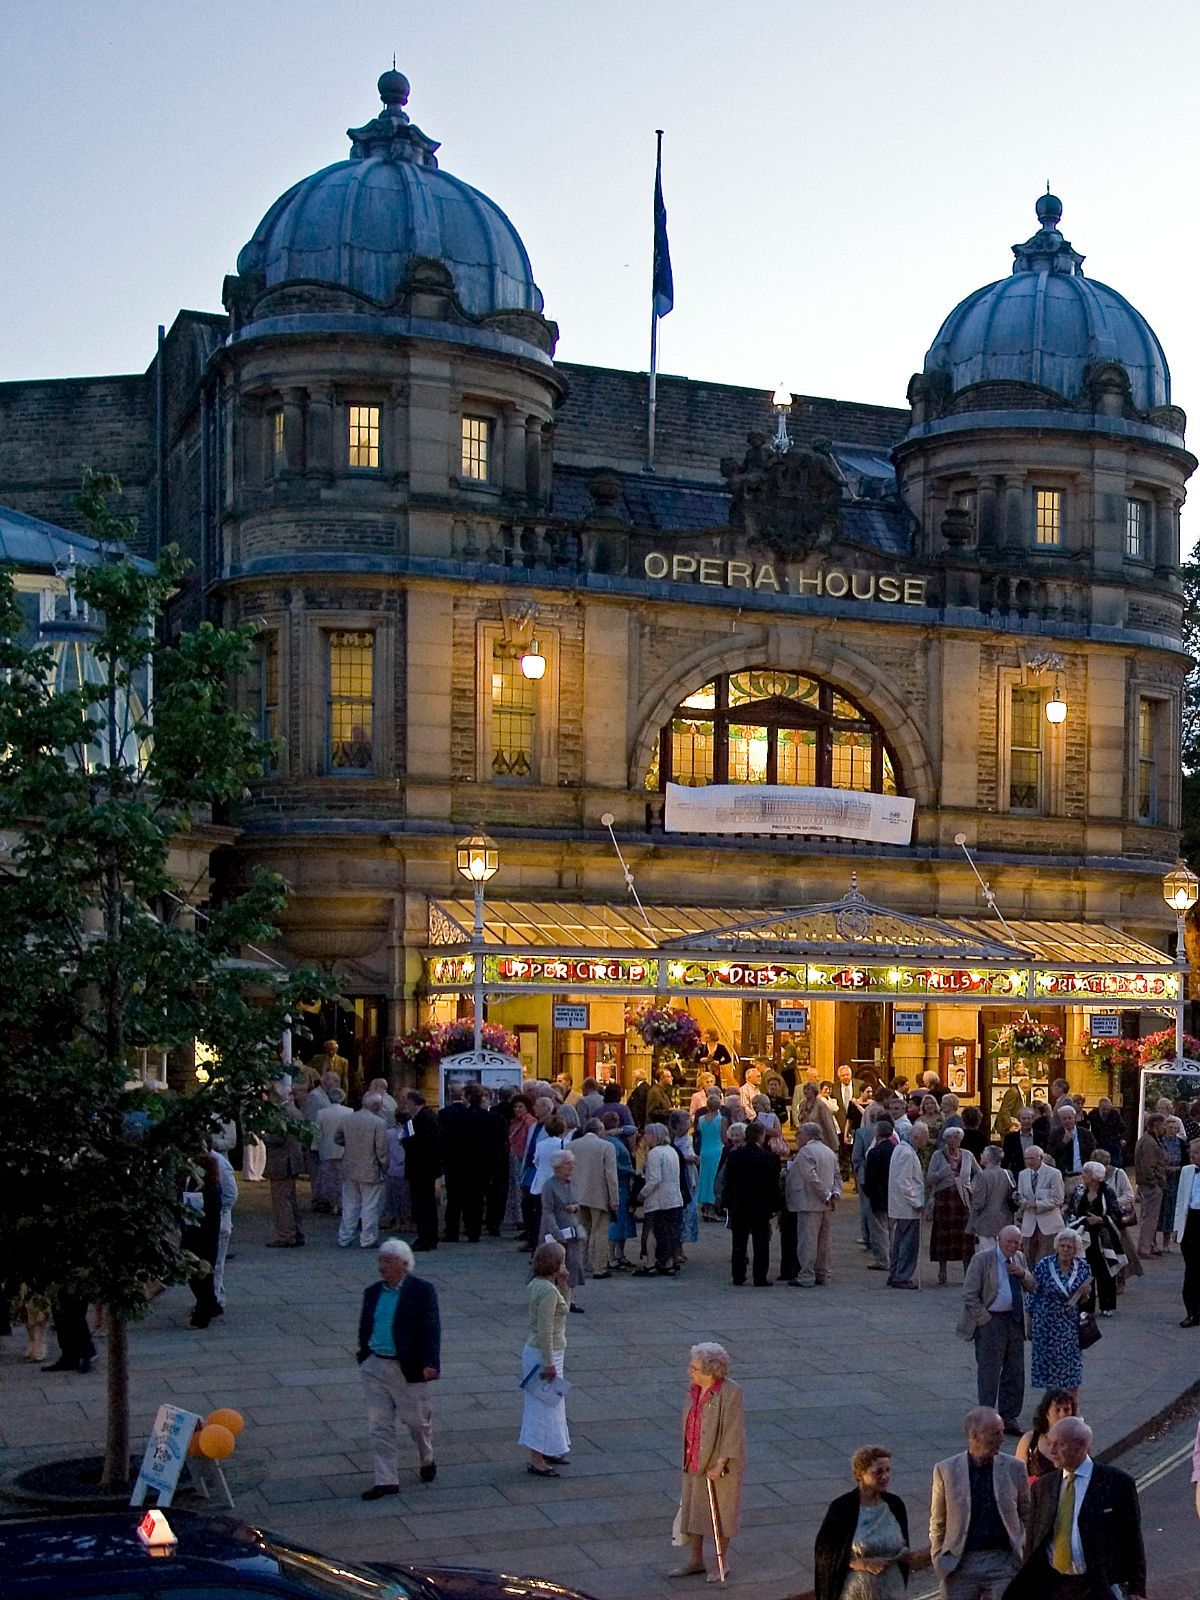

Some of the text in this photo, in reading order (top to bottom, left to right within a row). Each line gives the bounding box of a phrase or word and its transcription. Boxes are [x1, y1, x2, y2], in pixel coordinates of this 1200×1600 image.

[644, 552, 927, 605] OPERA HOUSE
[504, 960, 644, 981] UPPER CIRCLE
[728, 967, 789, 986] DRESS
[869, 975, 901, 985] AN
[901, 970, 971, 989] STALLS
